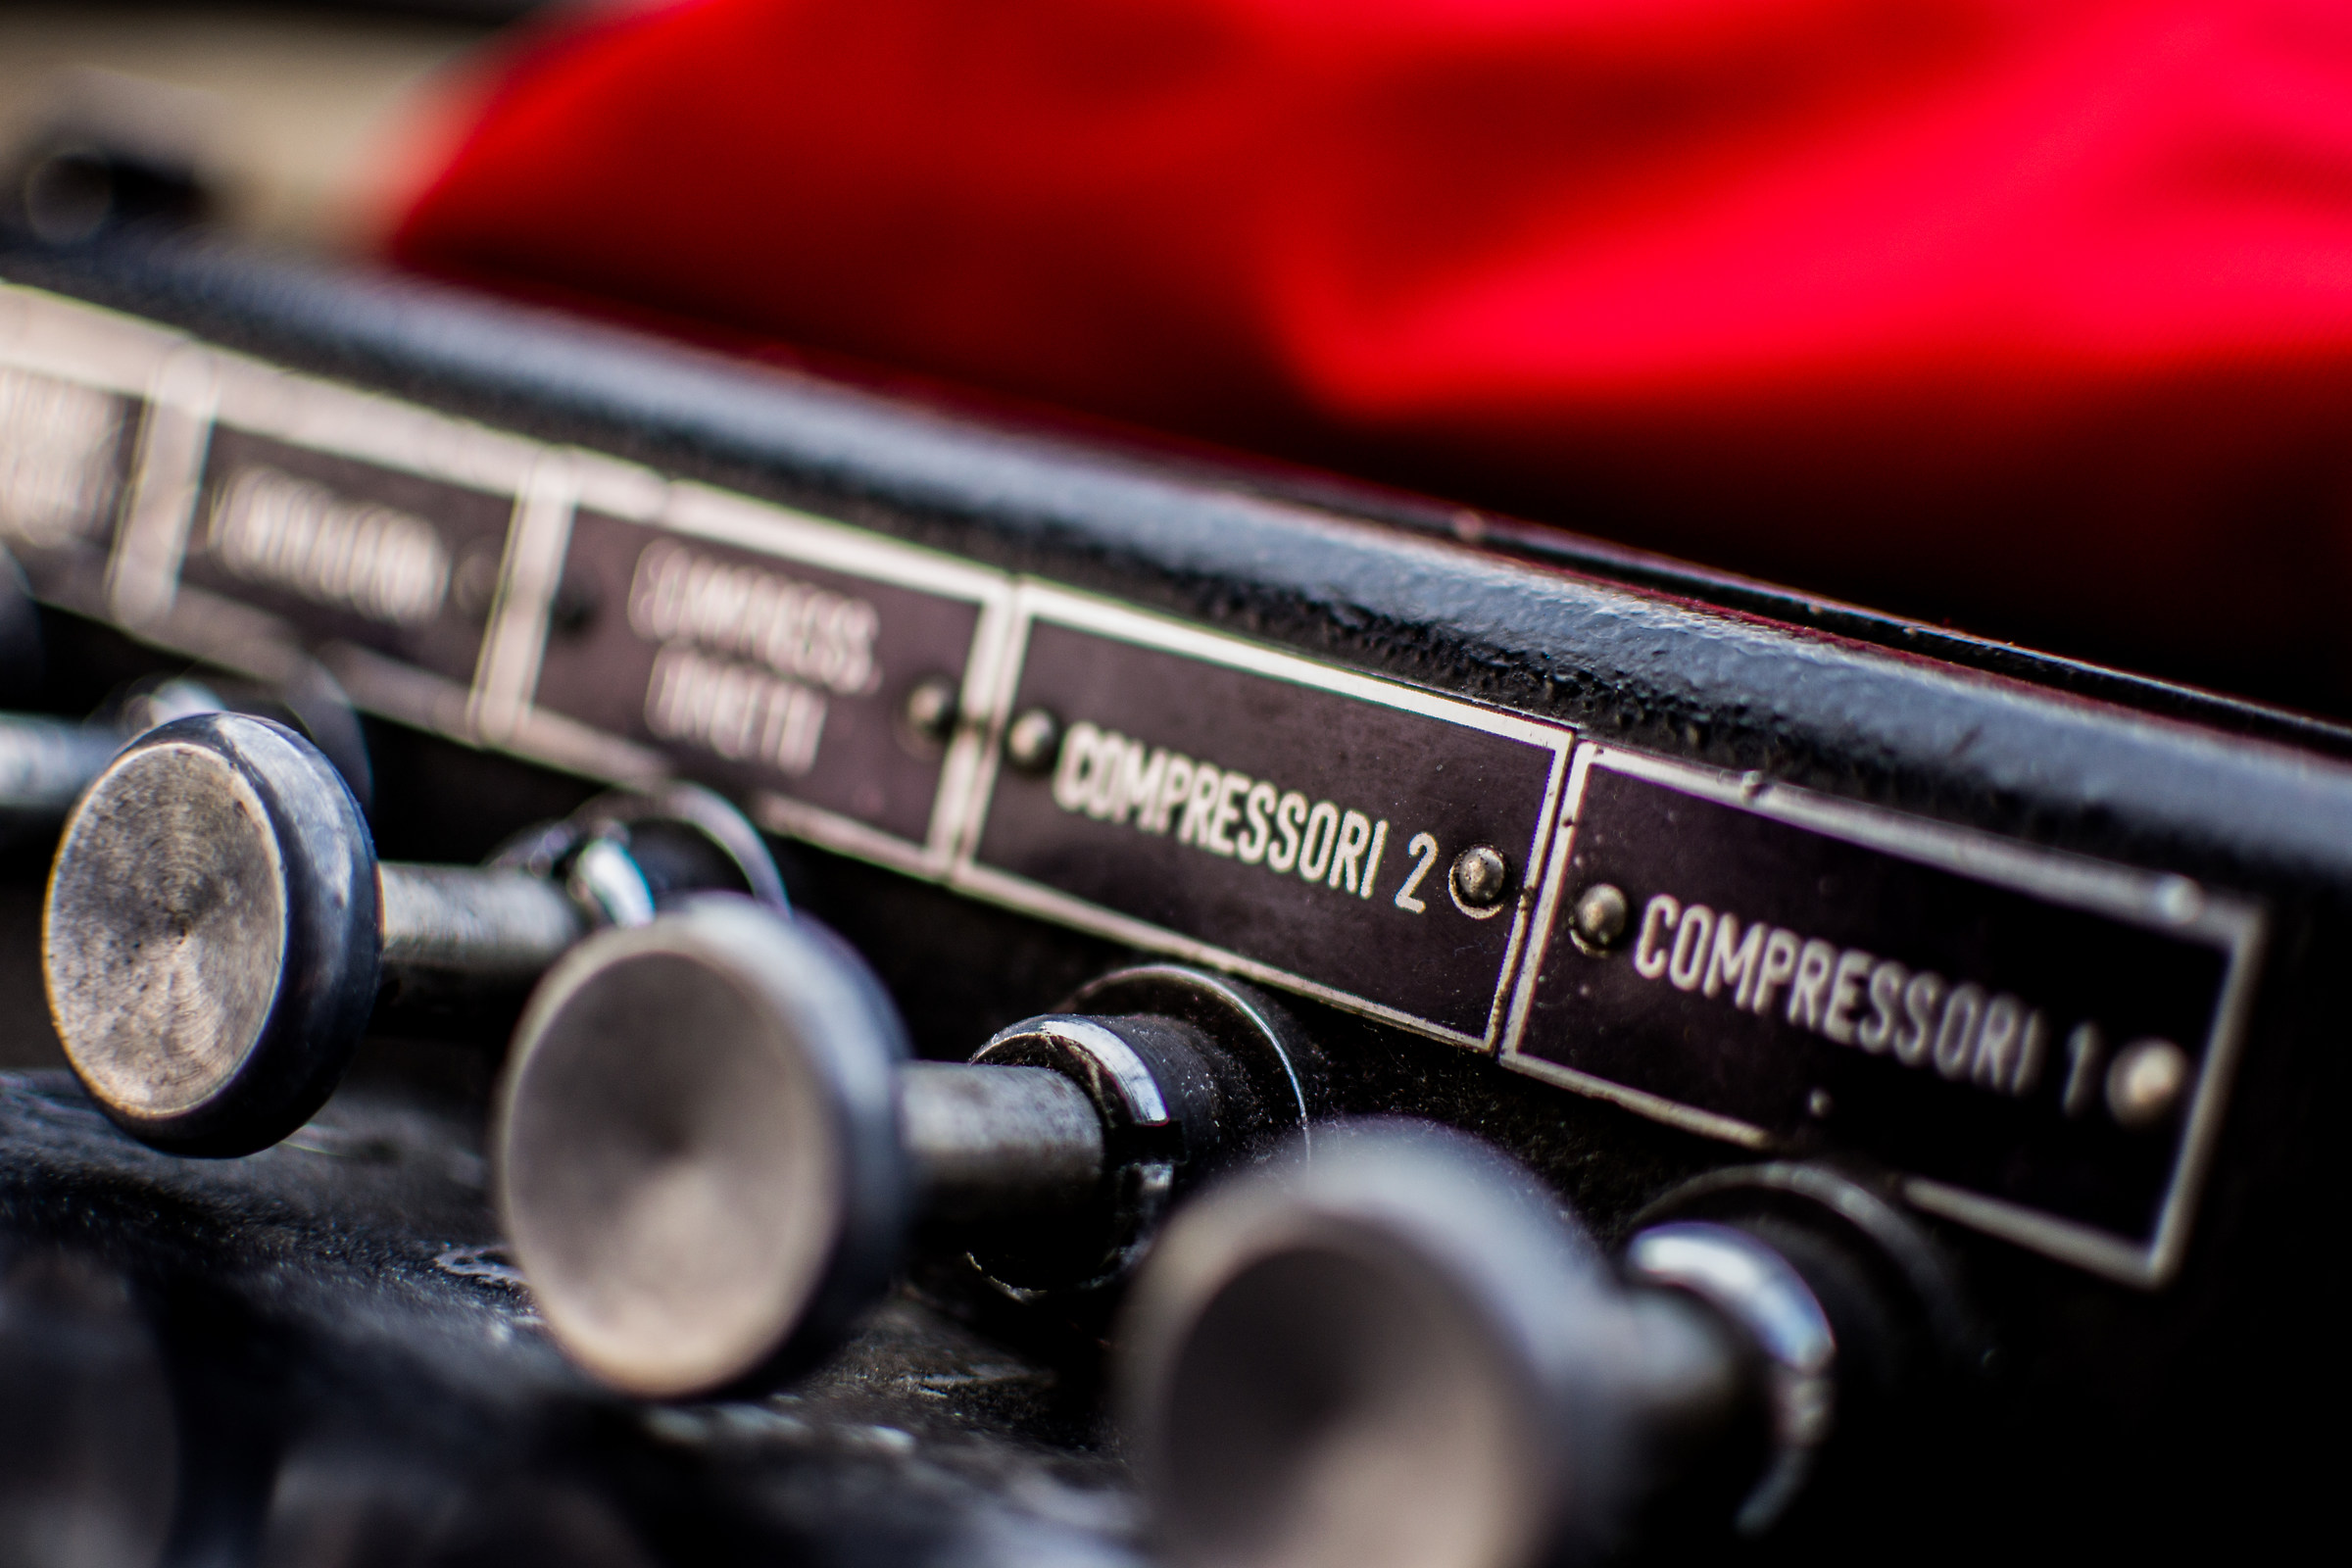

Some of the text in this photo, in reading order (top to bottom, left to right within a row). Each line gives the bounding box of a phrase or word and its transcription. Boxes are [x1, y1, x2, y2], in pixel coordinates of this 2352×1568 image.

[1054, 720, 1440, 914] COMPRESSORI 2
[1634, 893, 2102, 1118] COMPRESSORI 1
